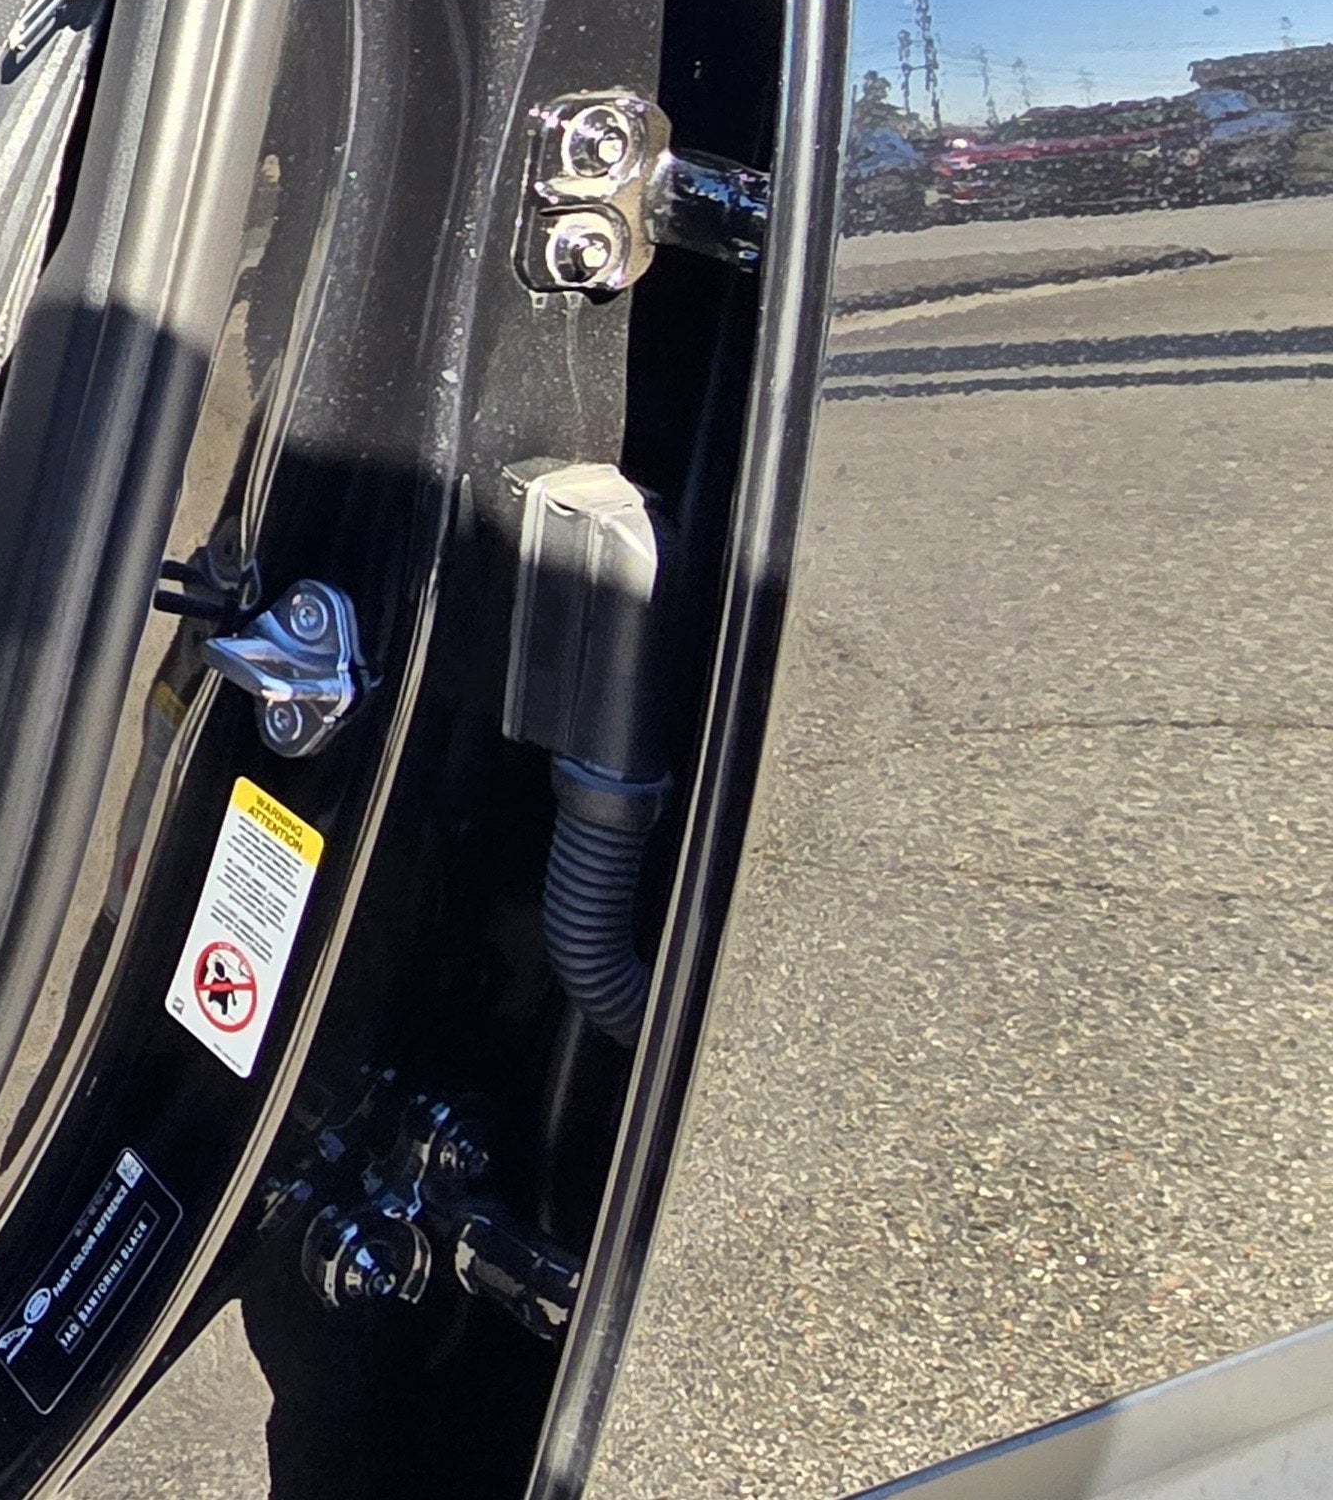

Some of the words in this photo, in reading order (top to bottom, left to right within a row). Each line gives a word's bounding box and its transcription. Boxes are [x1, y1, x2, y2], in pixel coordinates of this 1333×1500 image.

[247, 806, 303, 854] ATTENTION
[256, 795, 302, 838] WARNING
[120, 1220, 148, 1260] BLACK
[52, 1268, 73, 1298] PAINT
[70, 1234, 97, 1271] COLOUR
